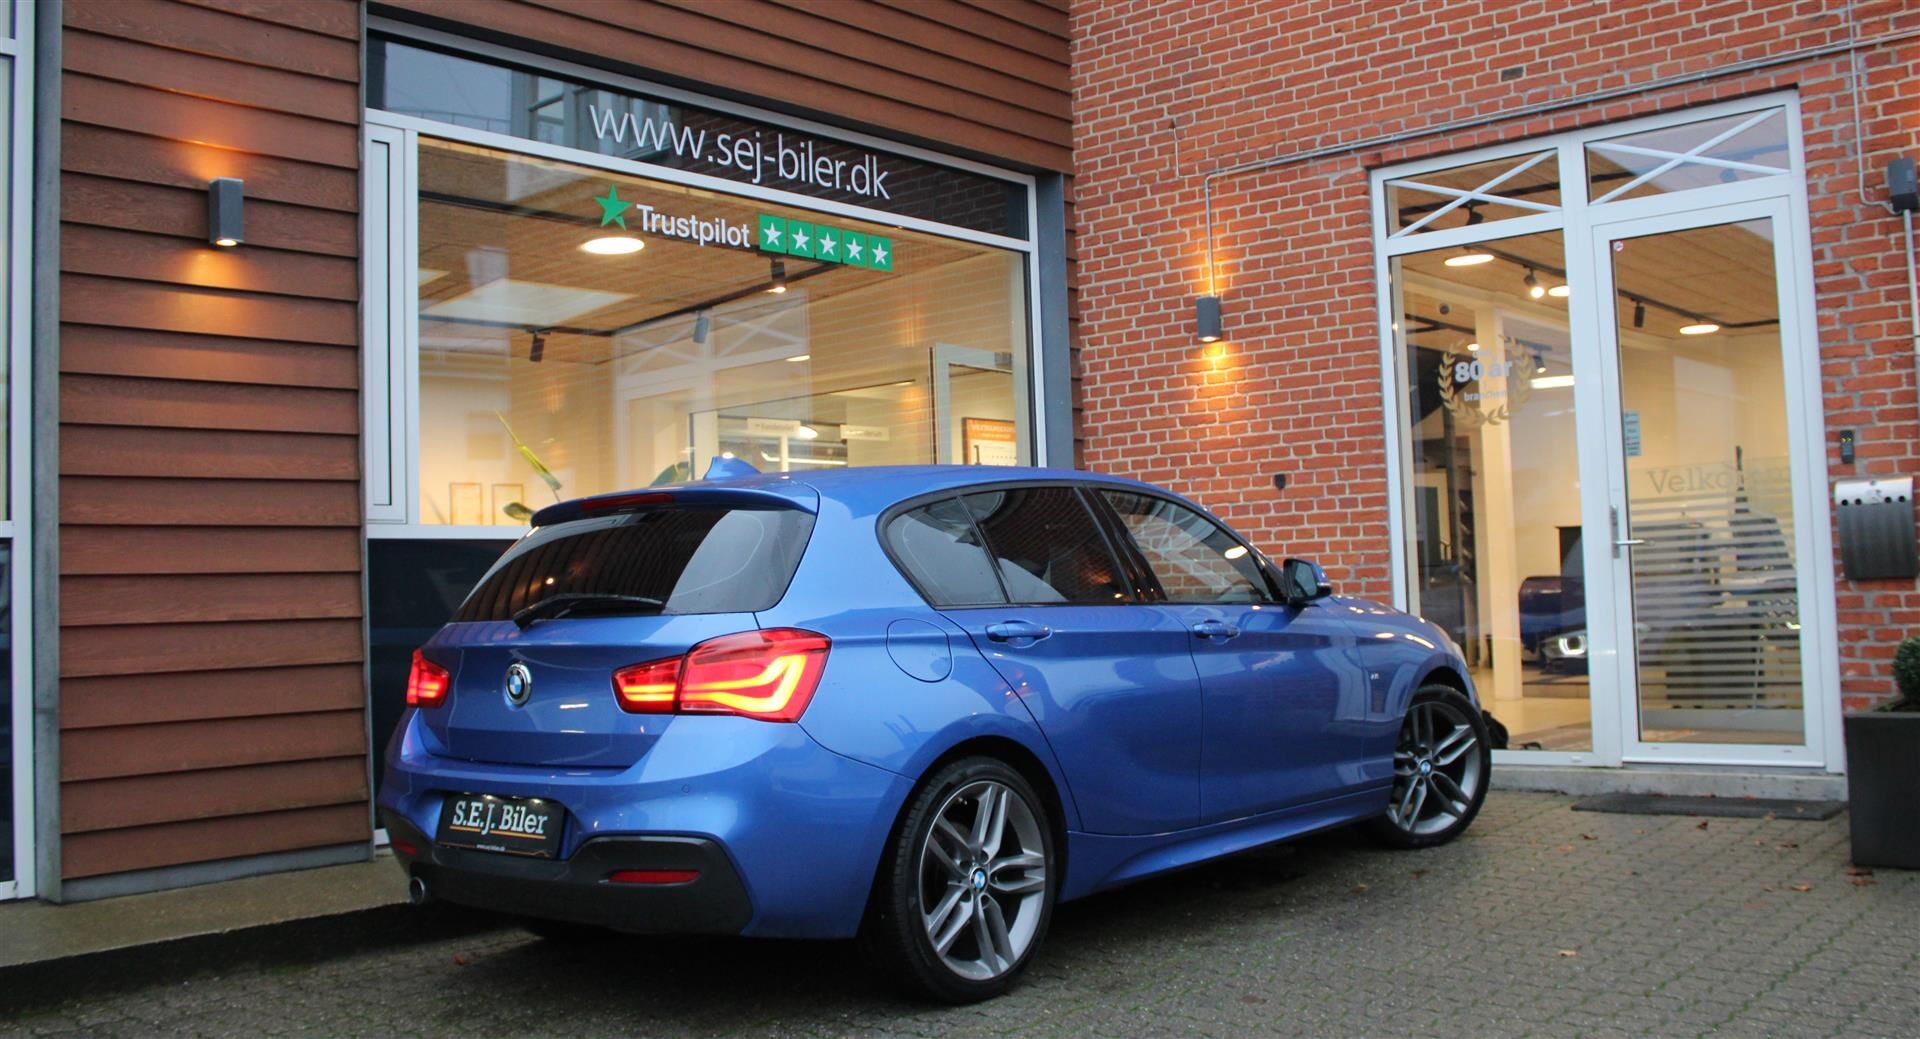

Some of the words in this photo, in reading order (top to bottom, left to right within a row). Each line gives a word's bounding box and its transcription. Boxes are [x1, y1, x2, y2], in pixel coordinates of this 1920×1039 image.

[589, 104, 891, 200] www.sej-biler.dk
[636, 203, 751, 249] Trustpilot
[1454, 360, 1485, 383] 80
[452, 801, 496, 836] S.E.J.
[498, 804, 549, 834] Biler
